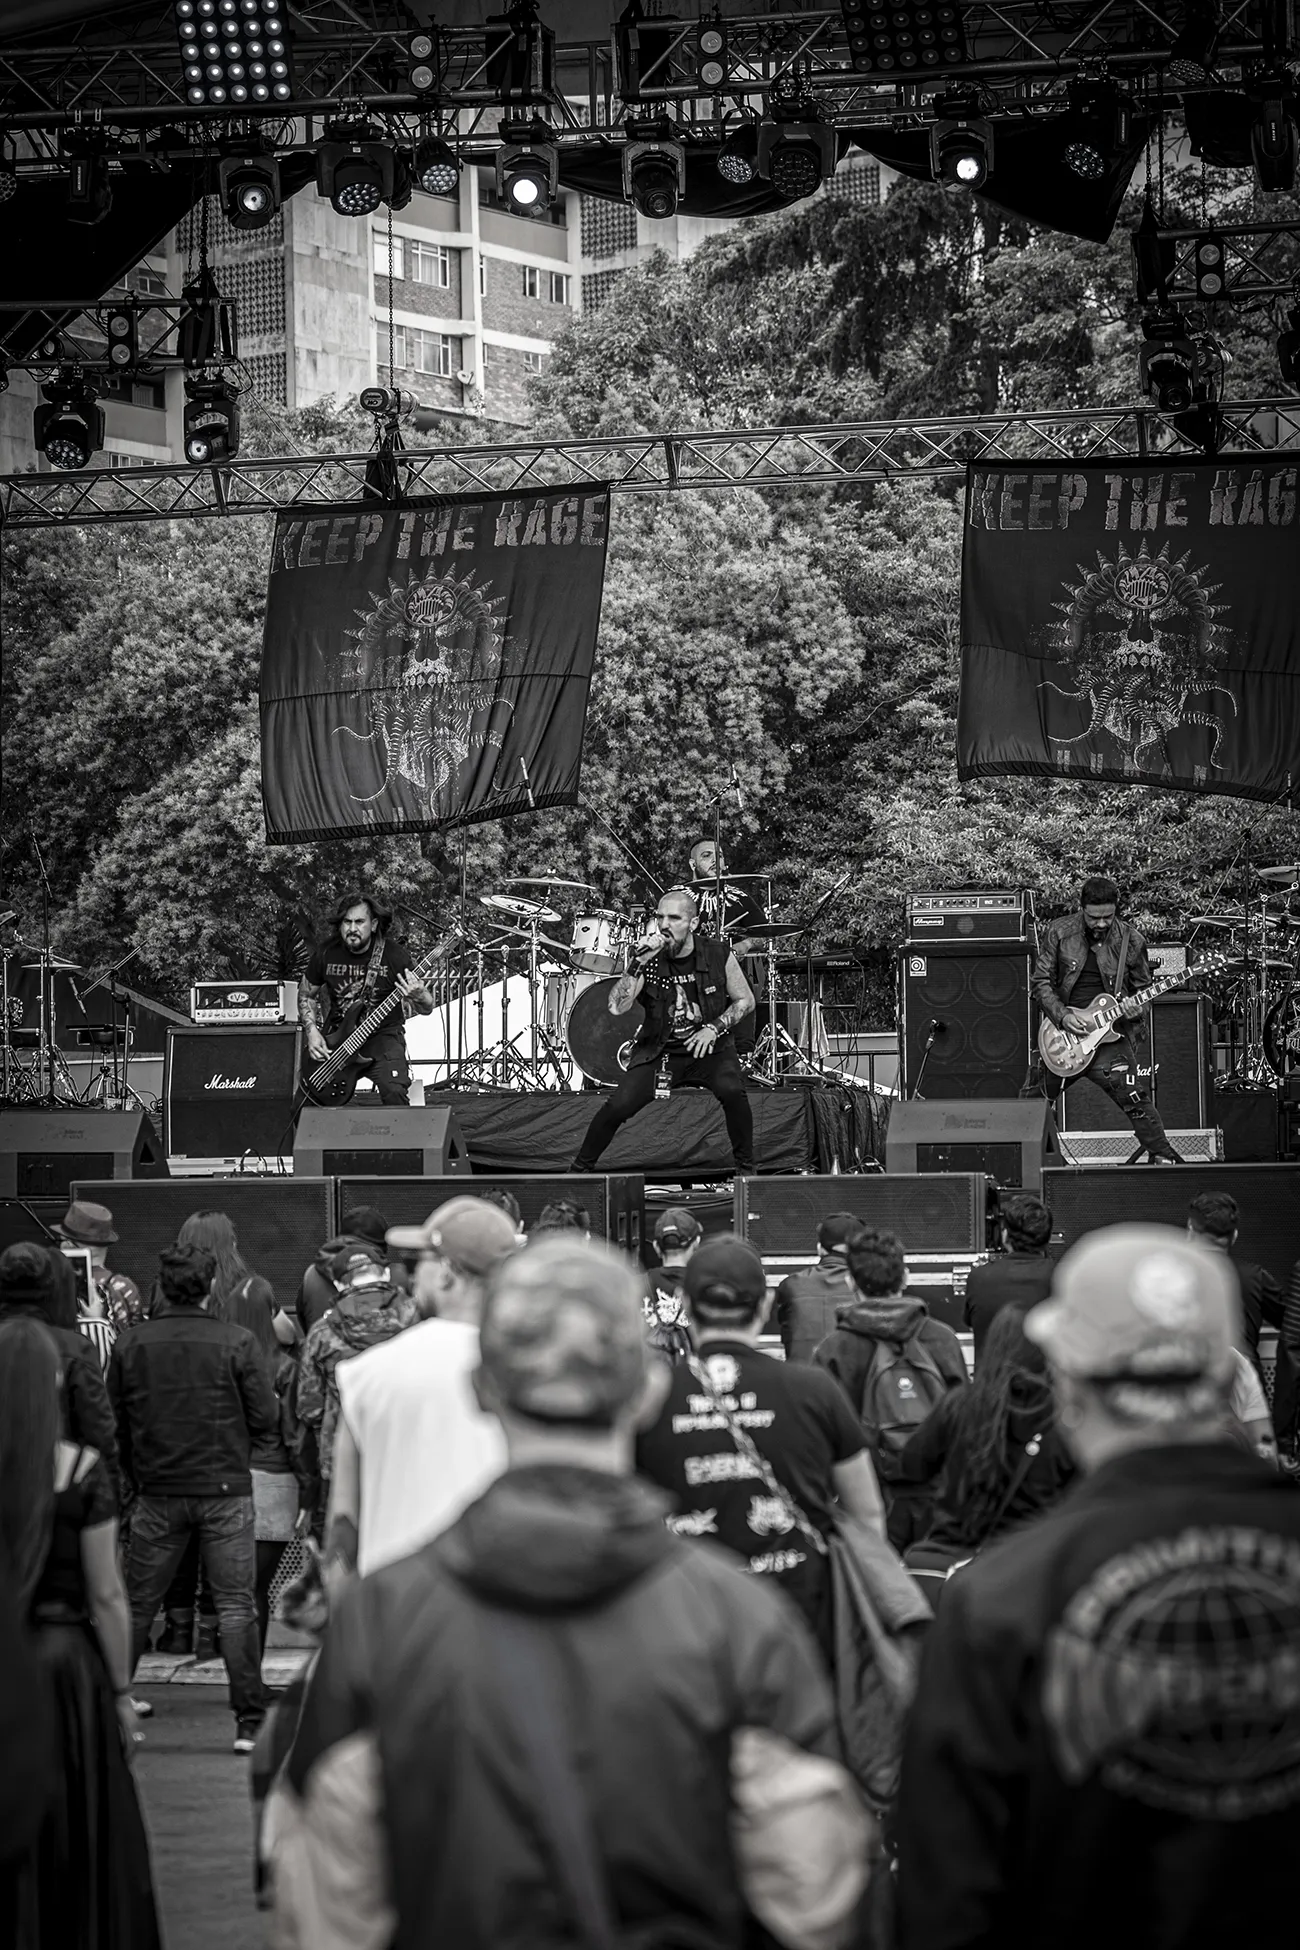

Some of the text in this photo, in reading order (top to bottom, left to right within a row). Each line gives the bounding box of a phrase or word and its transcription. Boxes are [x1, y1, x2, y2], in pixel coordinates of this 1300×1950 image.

[969, 467, 1300, 531] KEEP THE RAG
[271, 495, 606, 574] KEEP THE RAGE
[326, 963, 348, 976] KEEP
[348, 964, 365, 976] THE
[228, 992, 249, 1002] EVH
[204, 1074, 257, 1090] Marshall
